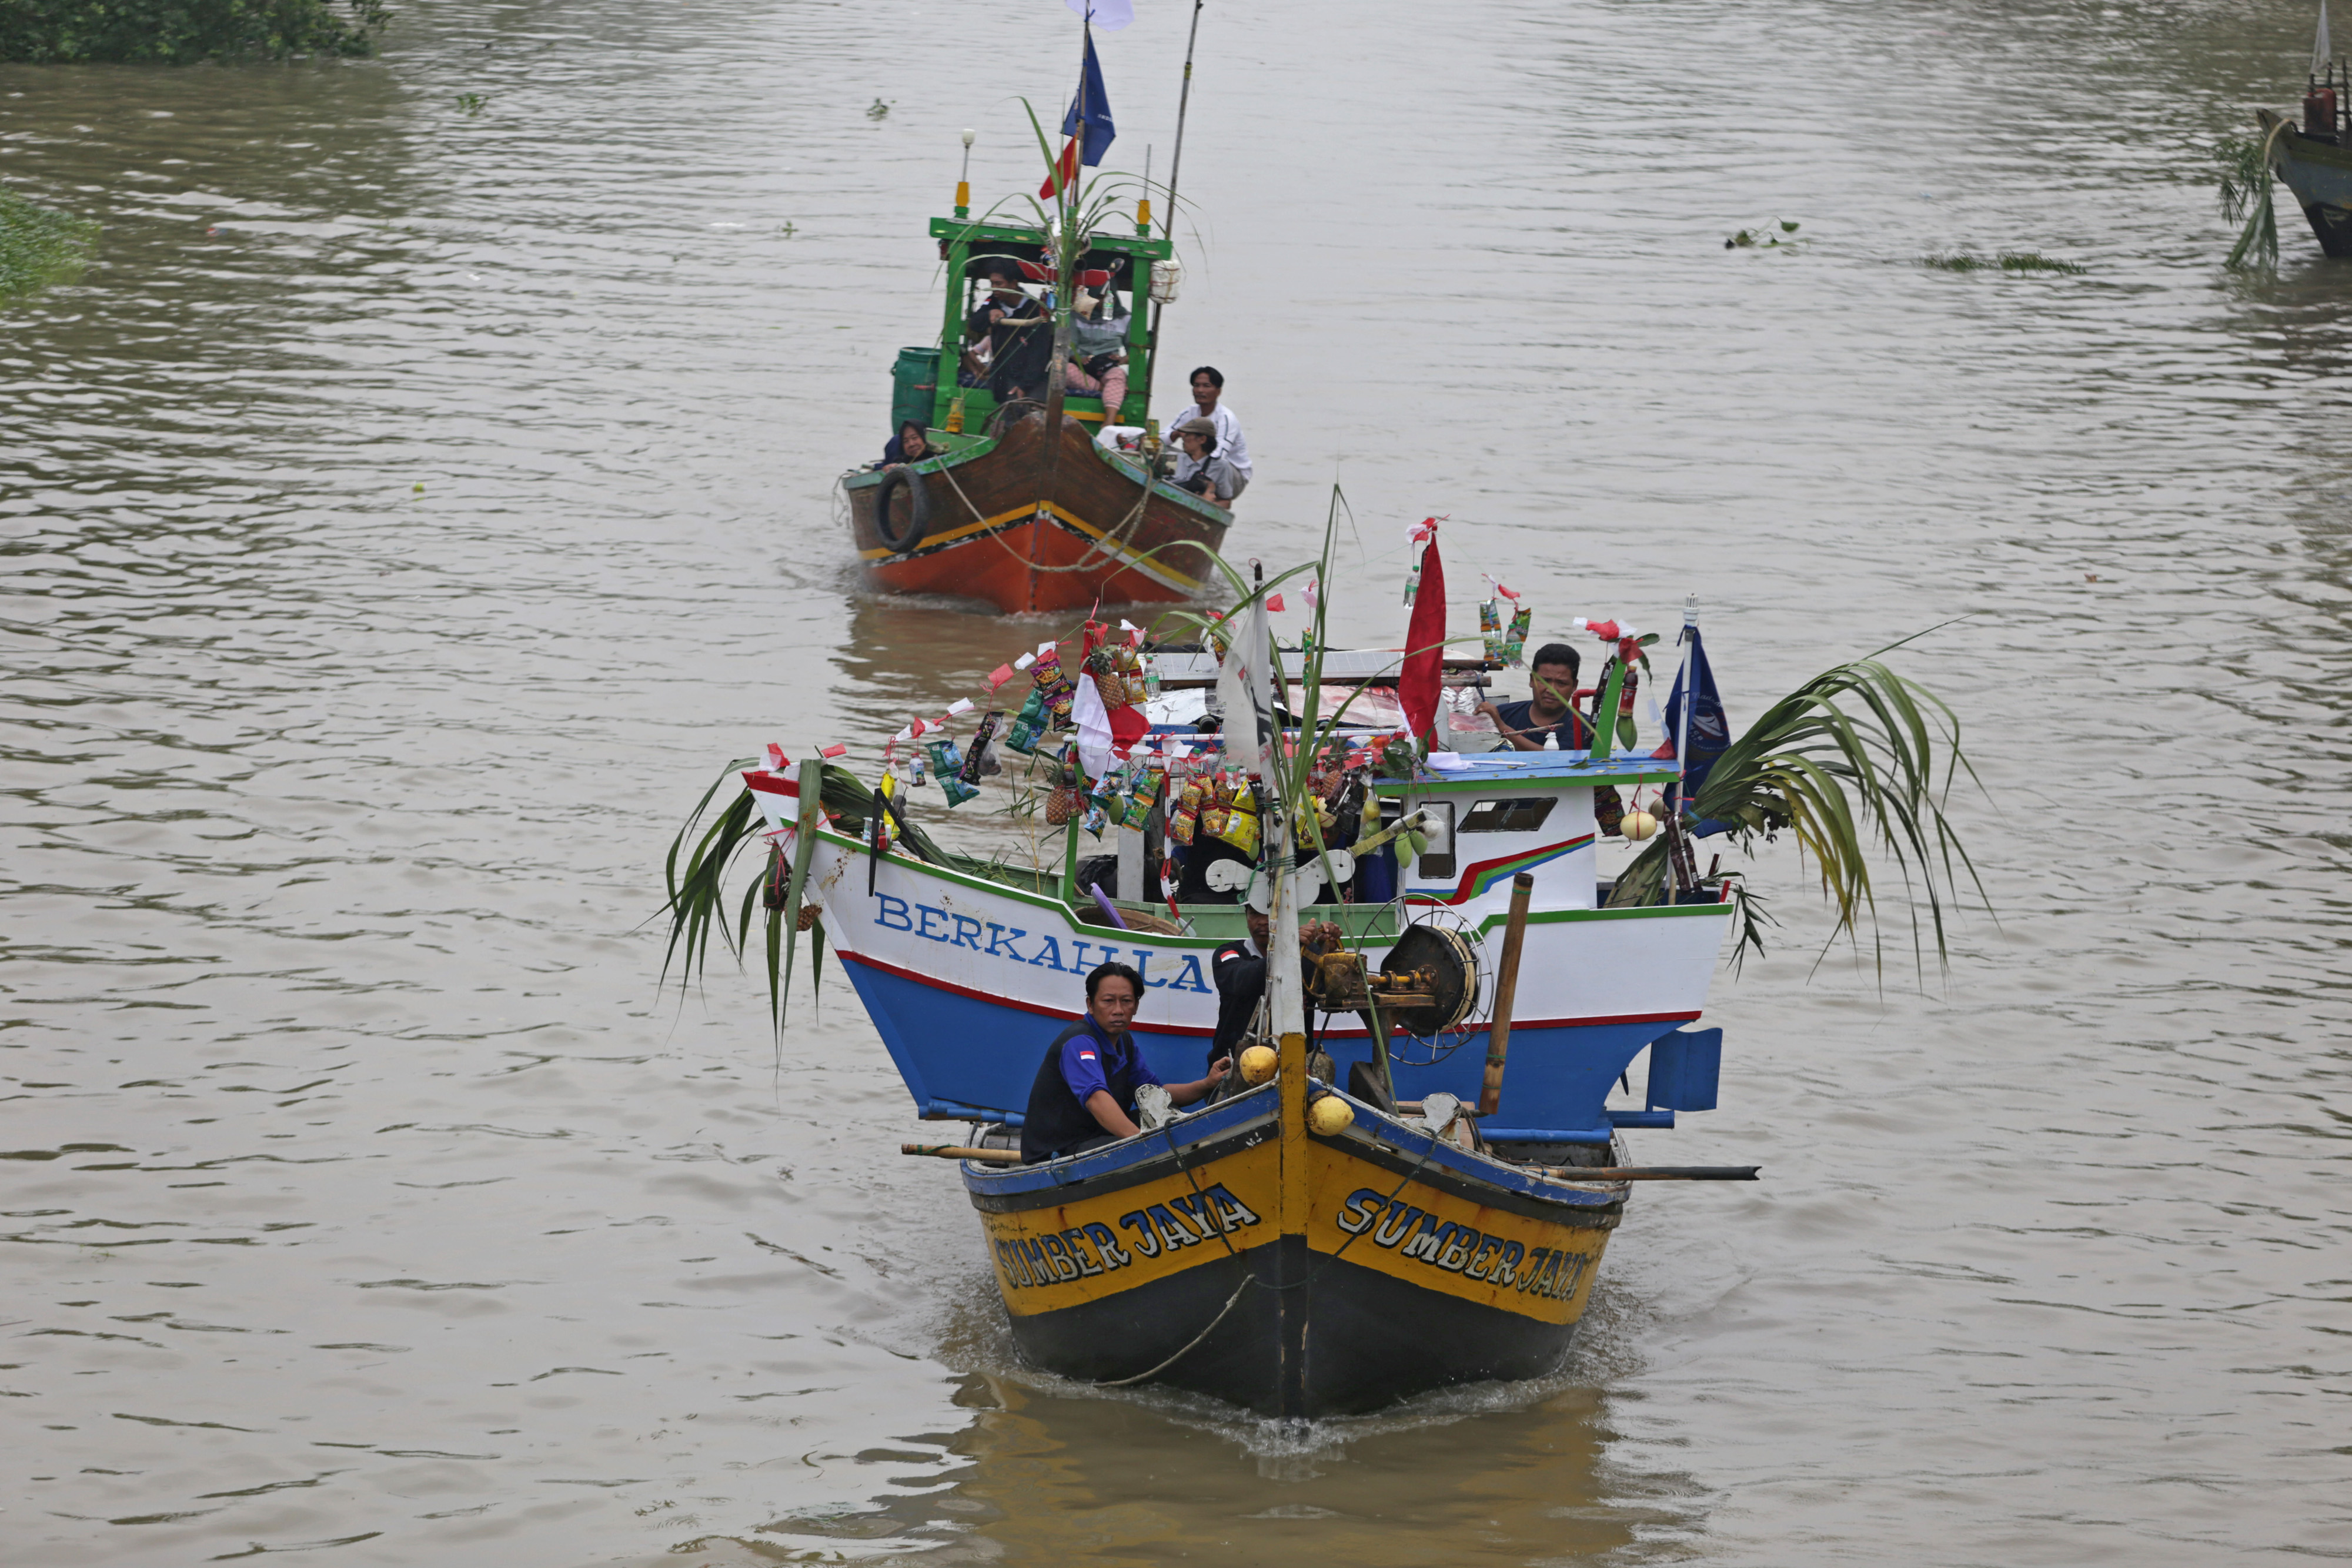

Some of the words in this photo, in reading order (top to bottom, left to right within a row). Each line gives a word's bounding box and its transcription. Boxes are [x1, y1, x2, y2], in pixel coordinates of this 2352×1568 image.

[874, 892, 1119, 975] BERKAH
[994, 1222, 1131, 1290] SUMBER
[1119, 1182, 1262, 1258] JAYA
[1337, 1188, 1525, 1287] SUMBER
[1517, 1247, 1587, 1302] JAYA
